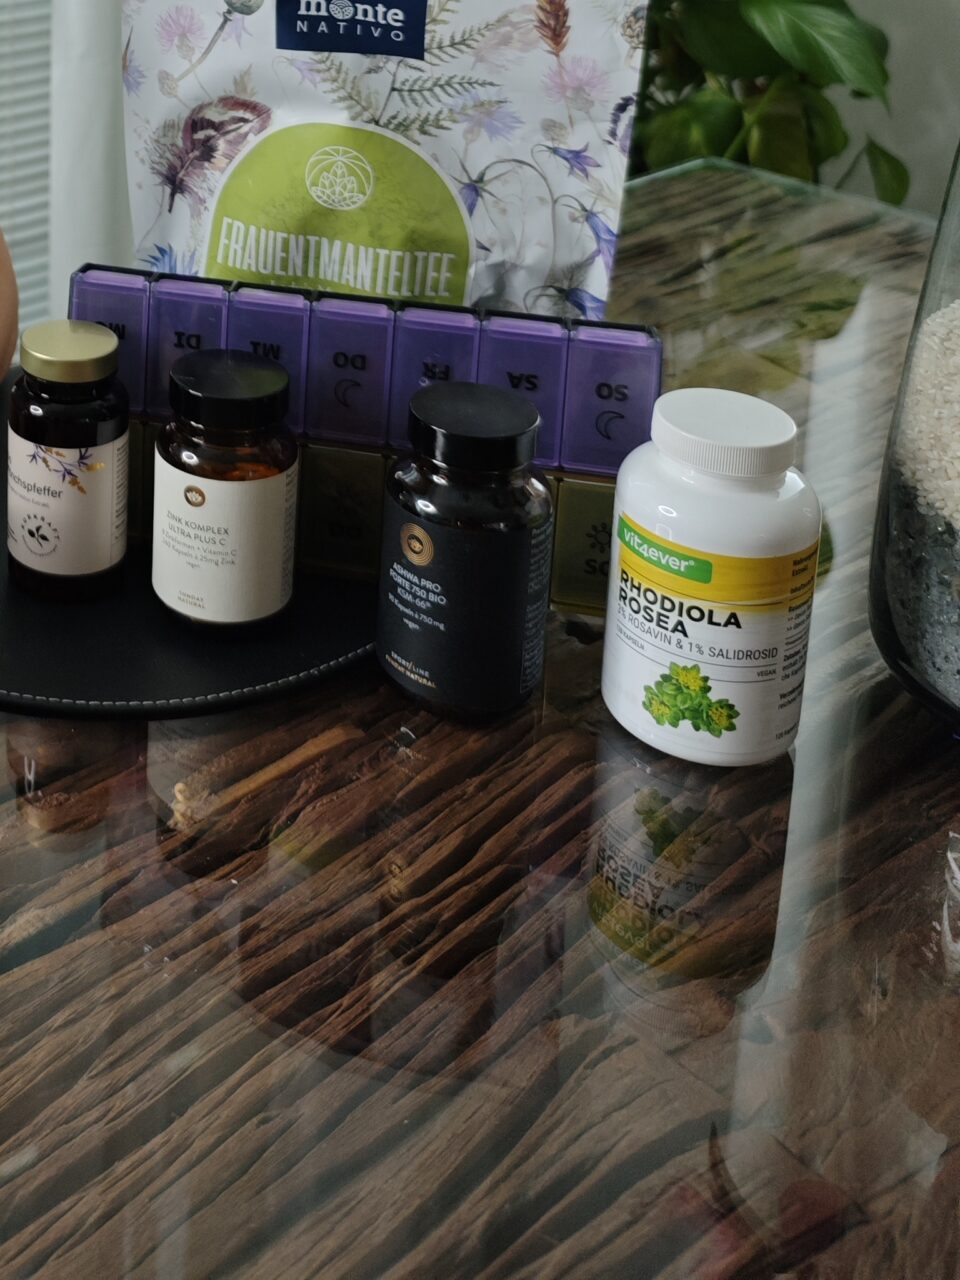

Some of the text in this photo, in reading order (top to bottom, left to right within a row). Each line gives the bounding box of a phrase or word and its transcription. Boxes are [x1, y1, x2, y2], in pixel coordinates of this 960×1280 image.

[296, 20, 404, 42] NATIVO
[216, 216, 456, 297] FRAUENTMANTELTEE
[174, 331, 202, 350] DI
[332, 351, 367, 370] DO
[505, 371, 540, 392] SA
[595, 382, 630, 402] SO
[167, 510, 230, 536] ZINK KOMPLEX
[168, 522, 227, 546] ULTRA PLUS C
[389, 568, 447, 605] FORTE 750 BIO
[420, 578, 442, 593] PRO
[620, 568, 742, 629] RHODIOLA
[618, 586, 689, 638] ROSEA
[628, 613, 672, 646] ROSAVIN
[675, 638, 684, 651] &
[687, 641, 705, 656] 1%
[708, 646, 779, 662] SALIDROSID
[756, 668, 777, 678] VEGAN
